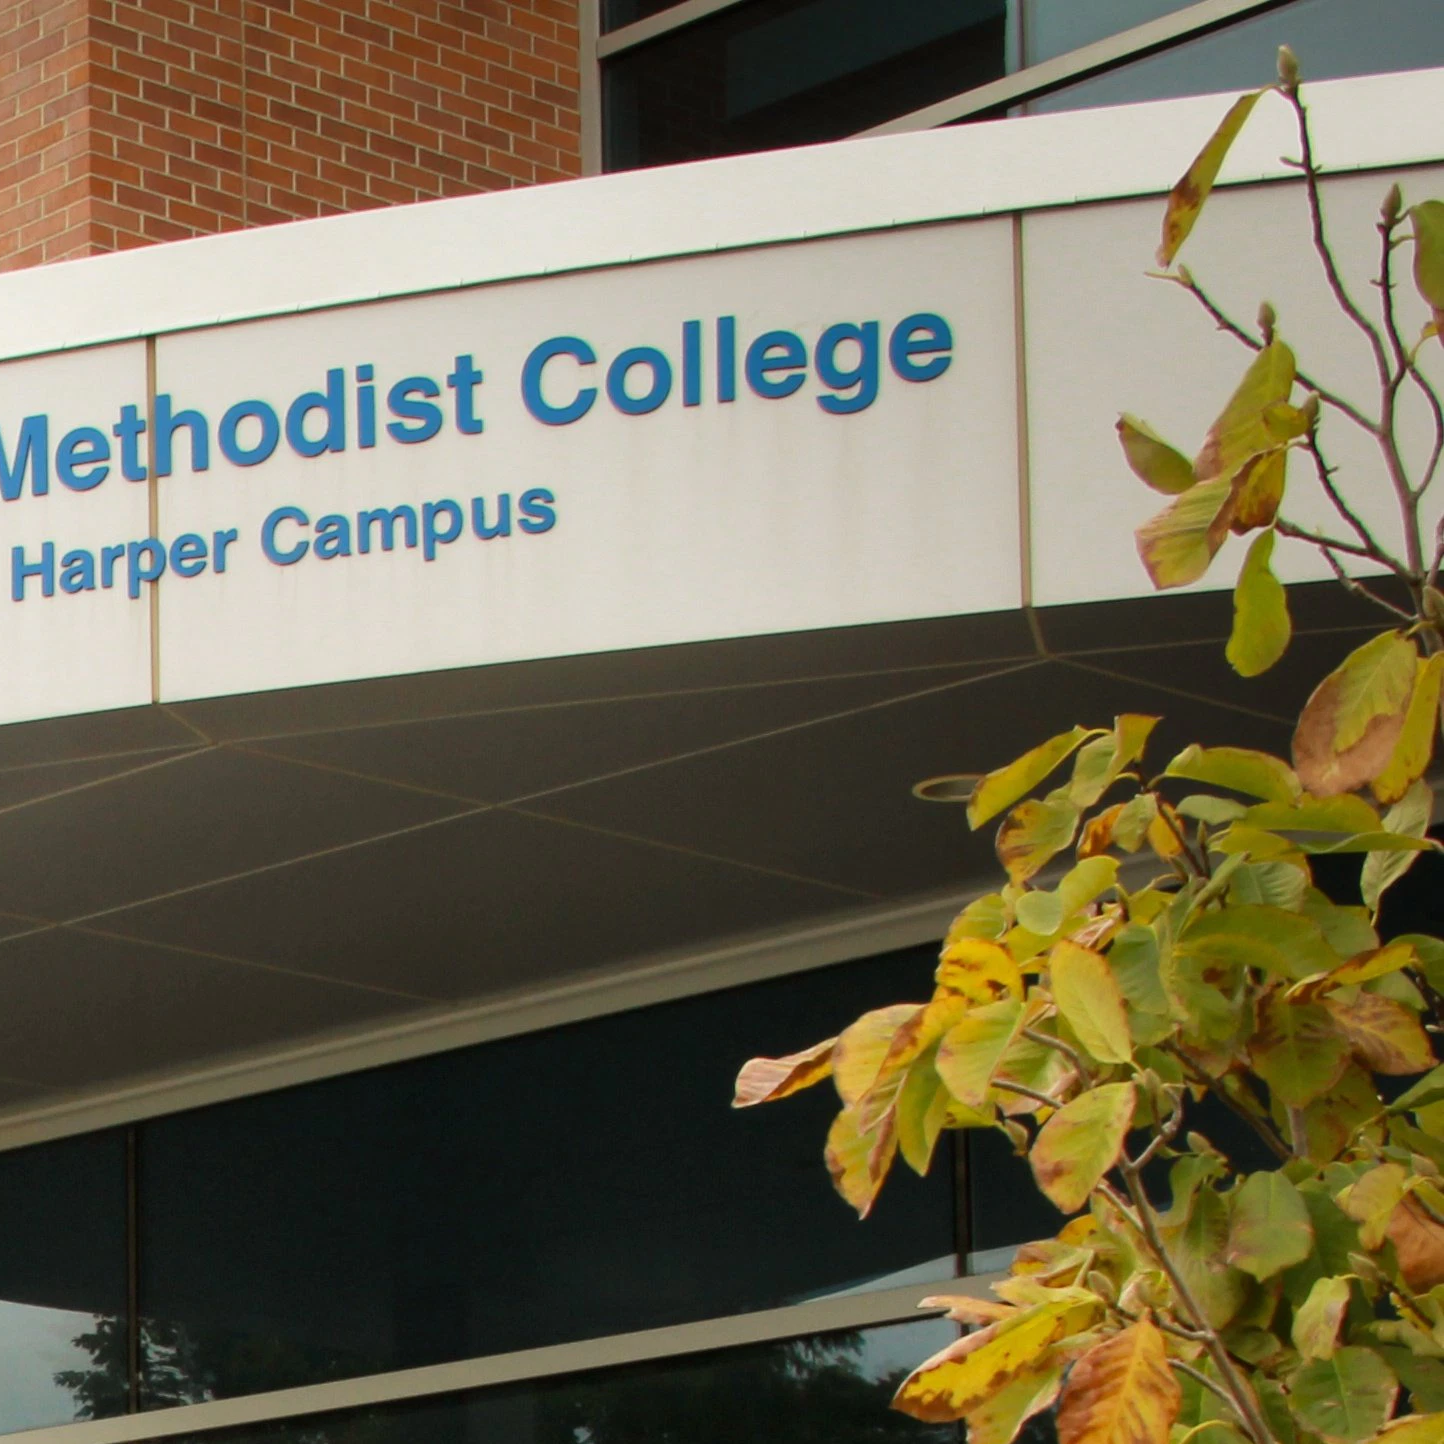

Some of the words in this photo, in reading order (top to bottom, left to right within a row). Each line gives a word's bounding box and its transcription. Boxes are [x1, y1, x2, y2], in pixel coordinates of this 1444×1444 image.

[524, 314, 954, 424] College
[13, 527, 239, 600] Harper
[263, 486, 557, 564] Campus
